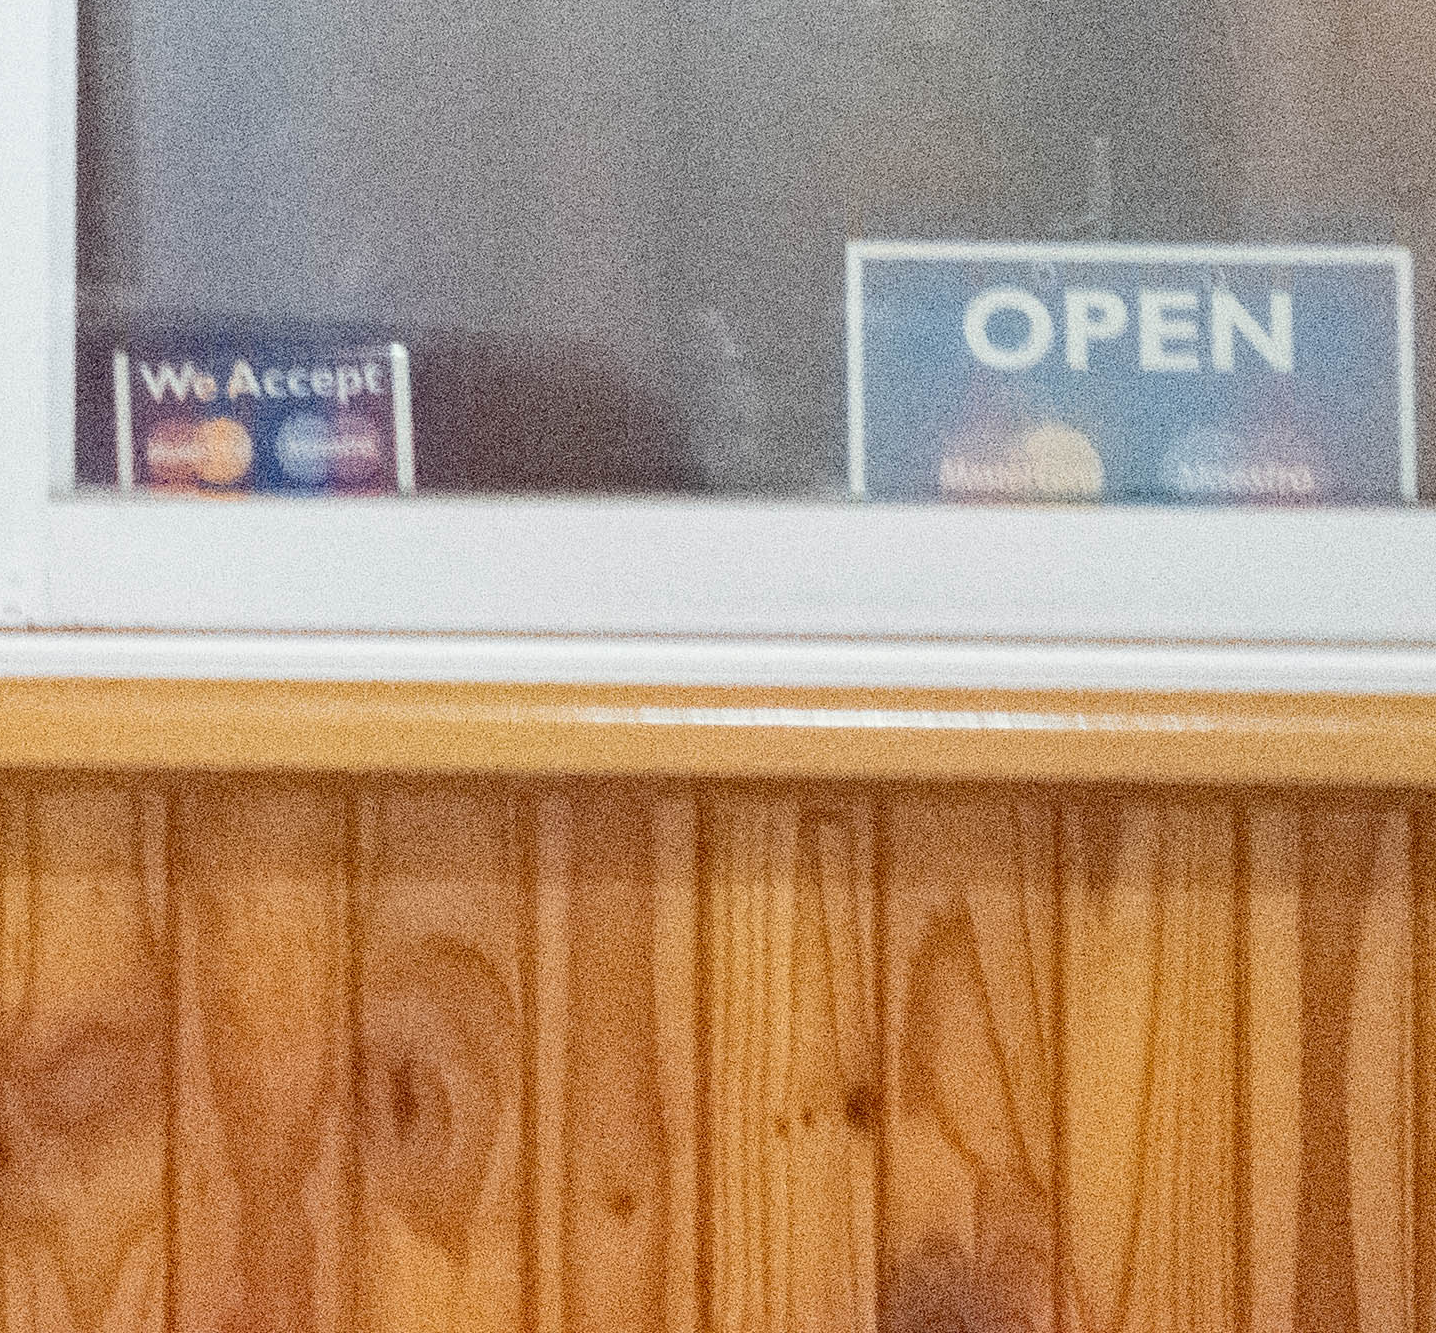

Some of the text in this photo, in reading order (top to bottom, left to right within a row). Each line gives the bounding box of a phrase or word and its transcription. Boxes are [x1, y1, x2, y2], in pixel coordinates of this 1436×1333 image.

[961, 285, 1295, 374] OPEN
[140, 356, 386, 408] We Accept
